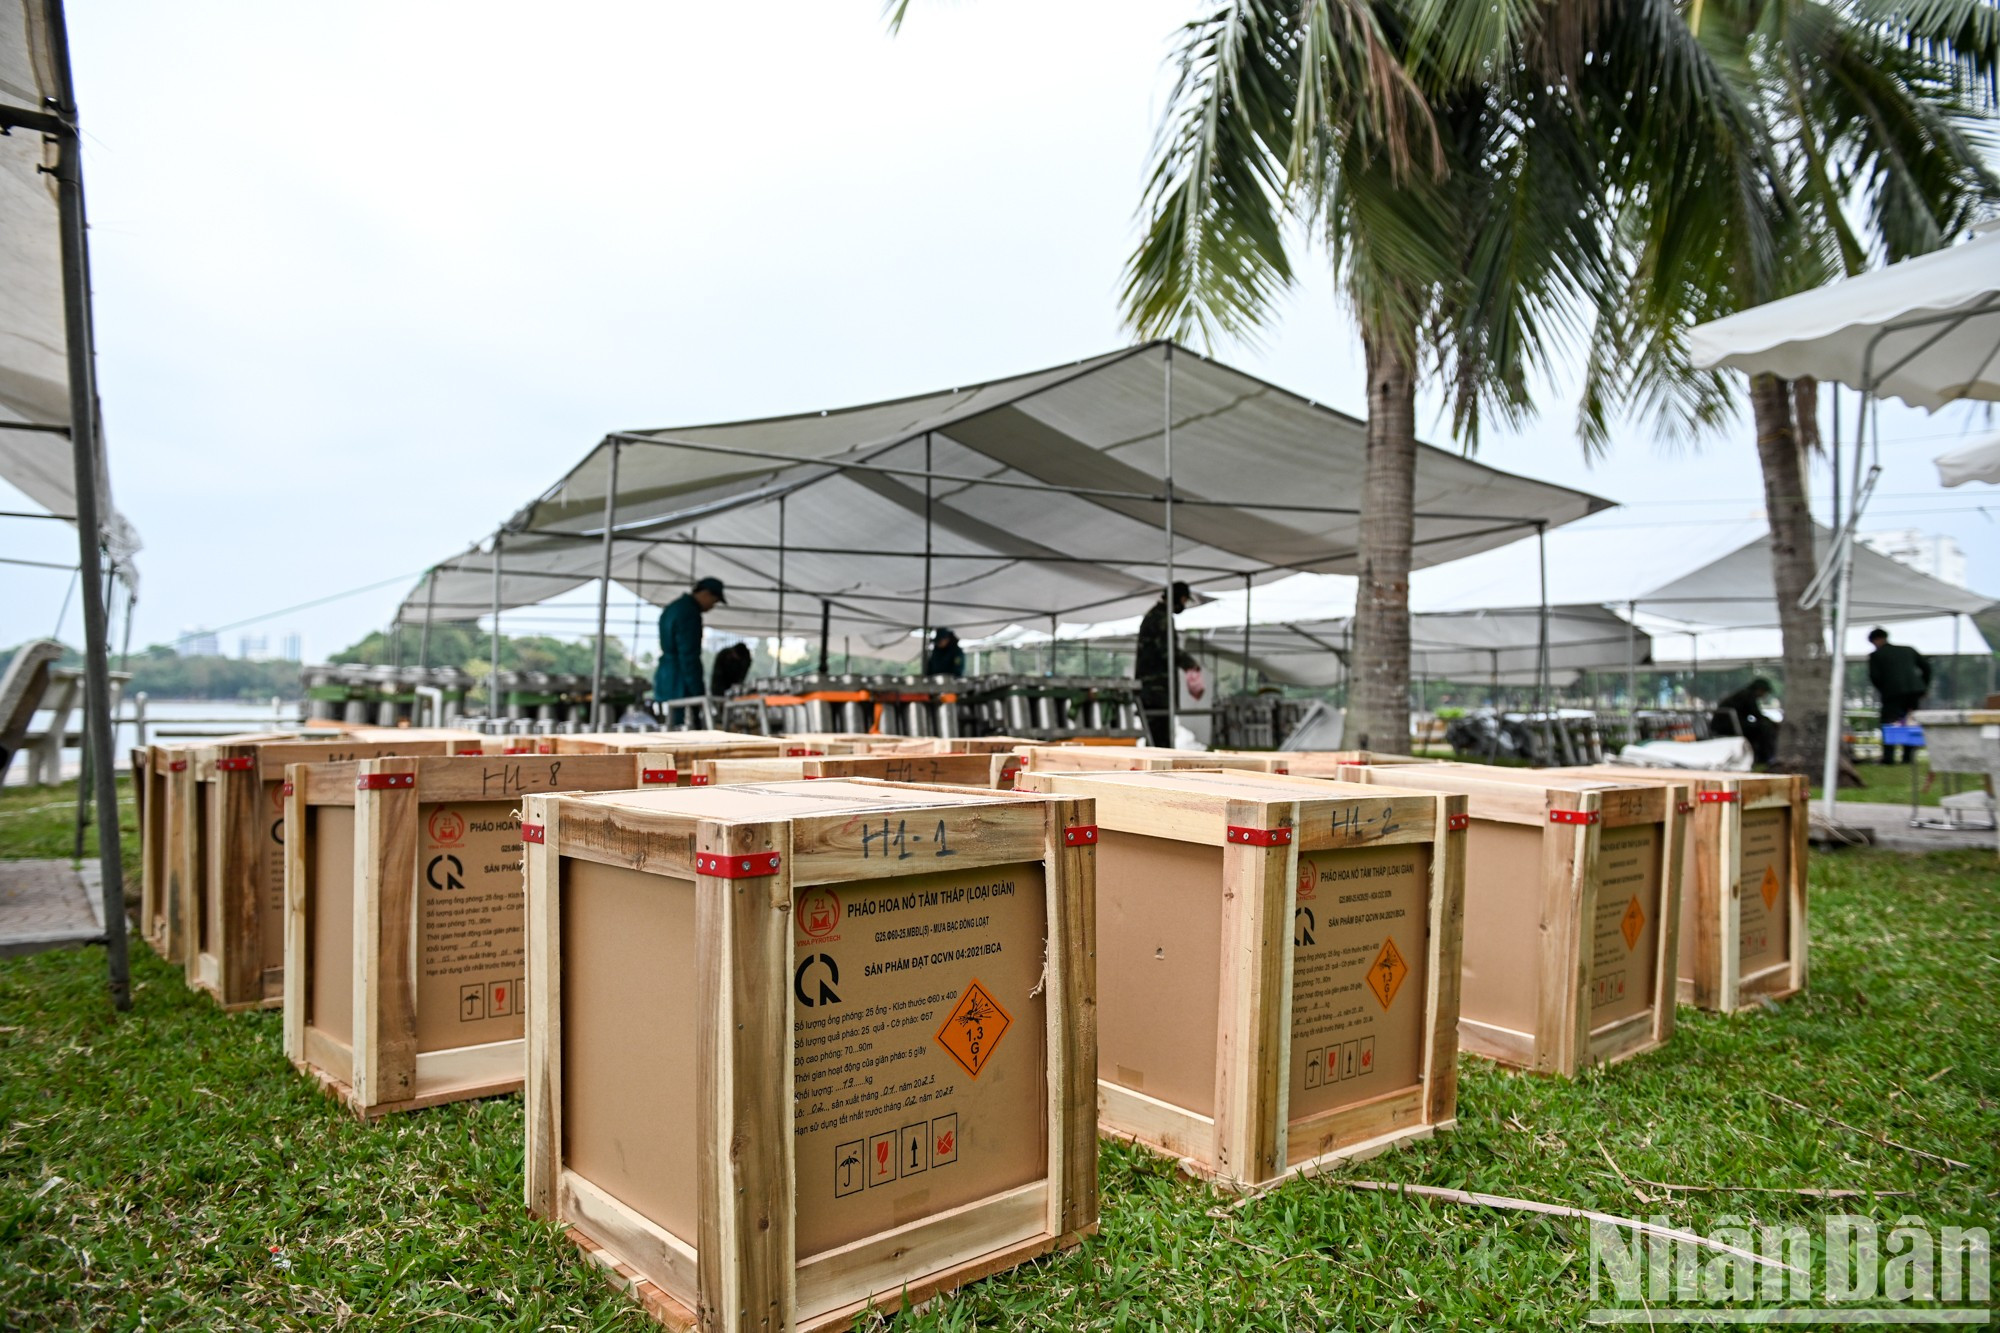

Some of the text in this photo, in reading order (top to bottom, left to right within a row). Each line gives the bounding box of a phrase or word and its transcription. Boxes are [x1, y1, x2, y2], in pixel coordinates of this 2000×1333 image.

[496, 821, 514, 831] HOA
[1338, 868, 1350, 880] HOA
[814, 898, 825, 910] 21
[848, 898, 876, 918] PHÁO
[879, 898, 900, 913] HOA
[912, 955, 929, 970] ĐẠT
[931, 950, 954, 965] QCVN
[956, 942, 1002, 960] 04:2021/BCA
[866, 1007, 874, 1017] 25
[946, 991, 957, 999] 400
[861, 1026, 870, 1035] 25
[966, 1026, 984, 1042] 1.3
[971, 1042, 979, 1054] G
[806, 1054, 819, 1064] cao
[812, 1070, 826, 1081] gian
[908, 1049, 912, 1058] 5
[973, 1055, 978, 1067] 1
